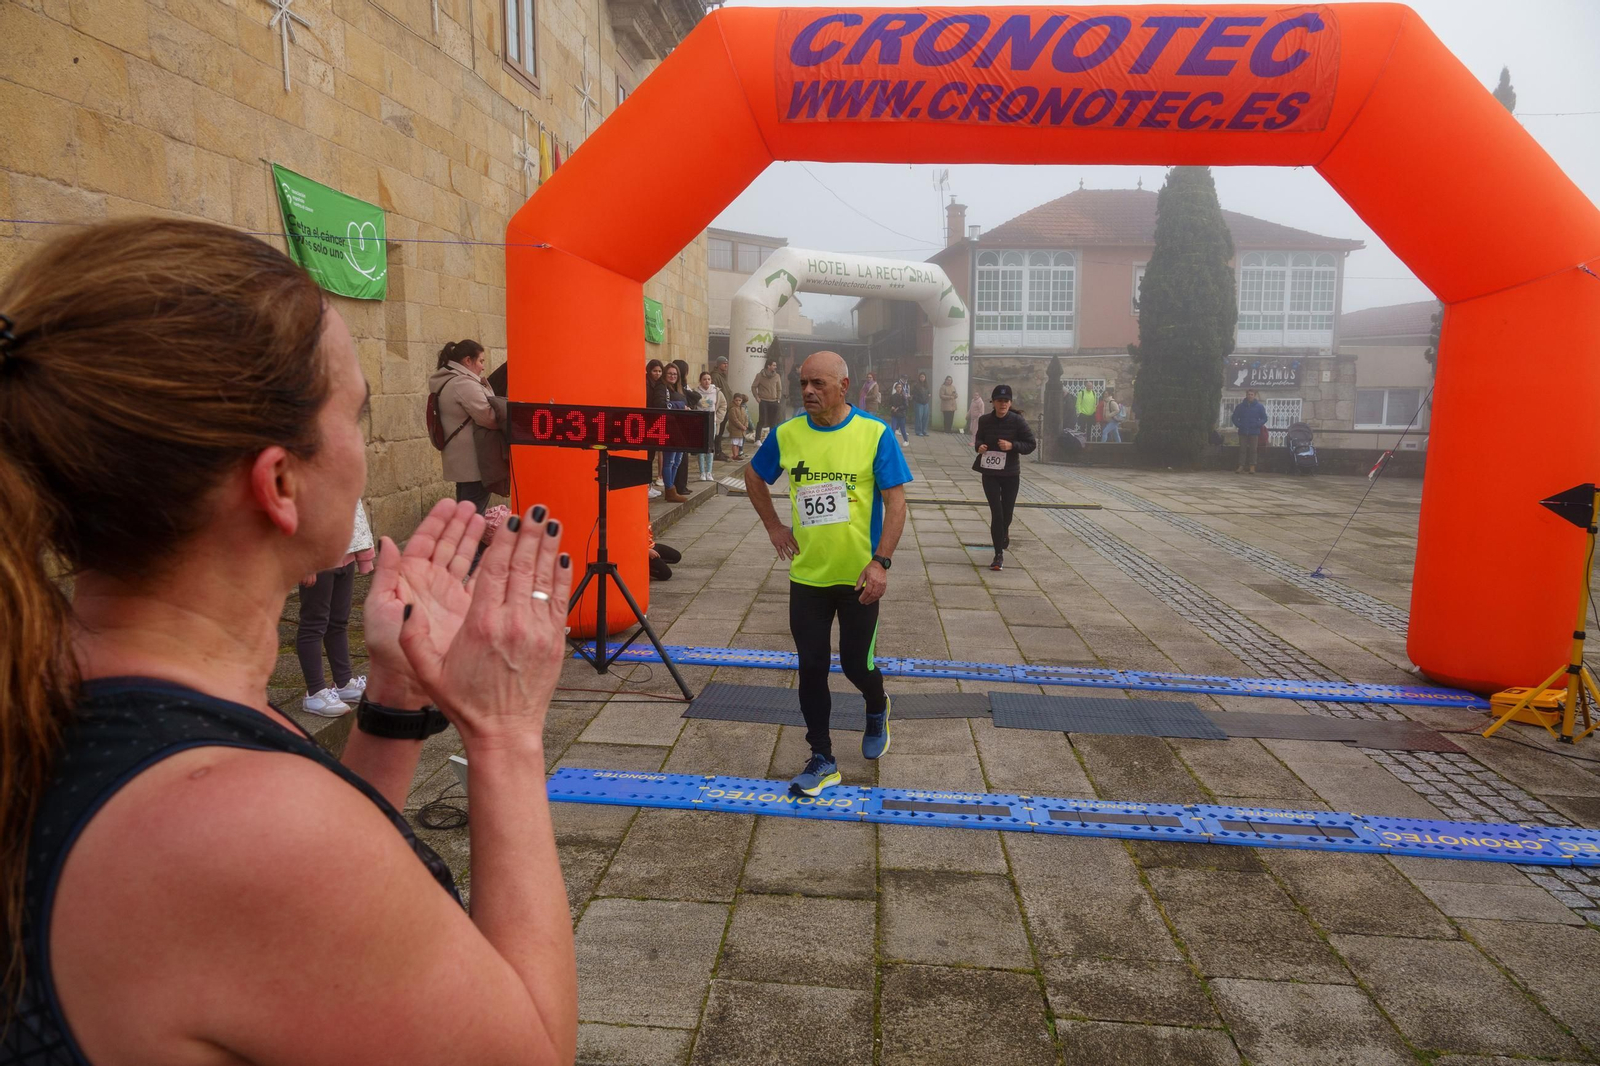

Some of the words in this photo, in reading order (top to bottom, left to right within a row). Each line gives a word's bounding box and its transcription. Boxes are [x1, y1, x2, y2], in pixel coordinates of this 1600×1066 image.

[789, 12, 1325, 79] CRONOTEC
[786, 80, 1310, 131] WWW.CRONOTEC.ES
[330, 248, 344, 259] uno
[807, 258, 850, 277] HOTEL
[857, 264, 872, 278] LA
[806, 277, 881, 290] www.hotelrectoral.com
[532, 409, 669, 445] 0:31:04
[985, 456, 1001, 465] 650
[804, 495, 836, 516] 563
[688, 652, 785, 662] CRONOTEC
[1368, 688, 1476, 701] CRONOTEC
[593, 772, 667, 781] CRONOTEC
[707, 788, 853, 807] CRONOTEC
[906, 791, 983, 800] CRONOTEC
[1068, 801, 1147, 811] CRONOTEC
[1235, 809, 1316, 820] CRONOTEC
[1382, 831, 1543, 850] CRONOTEC
